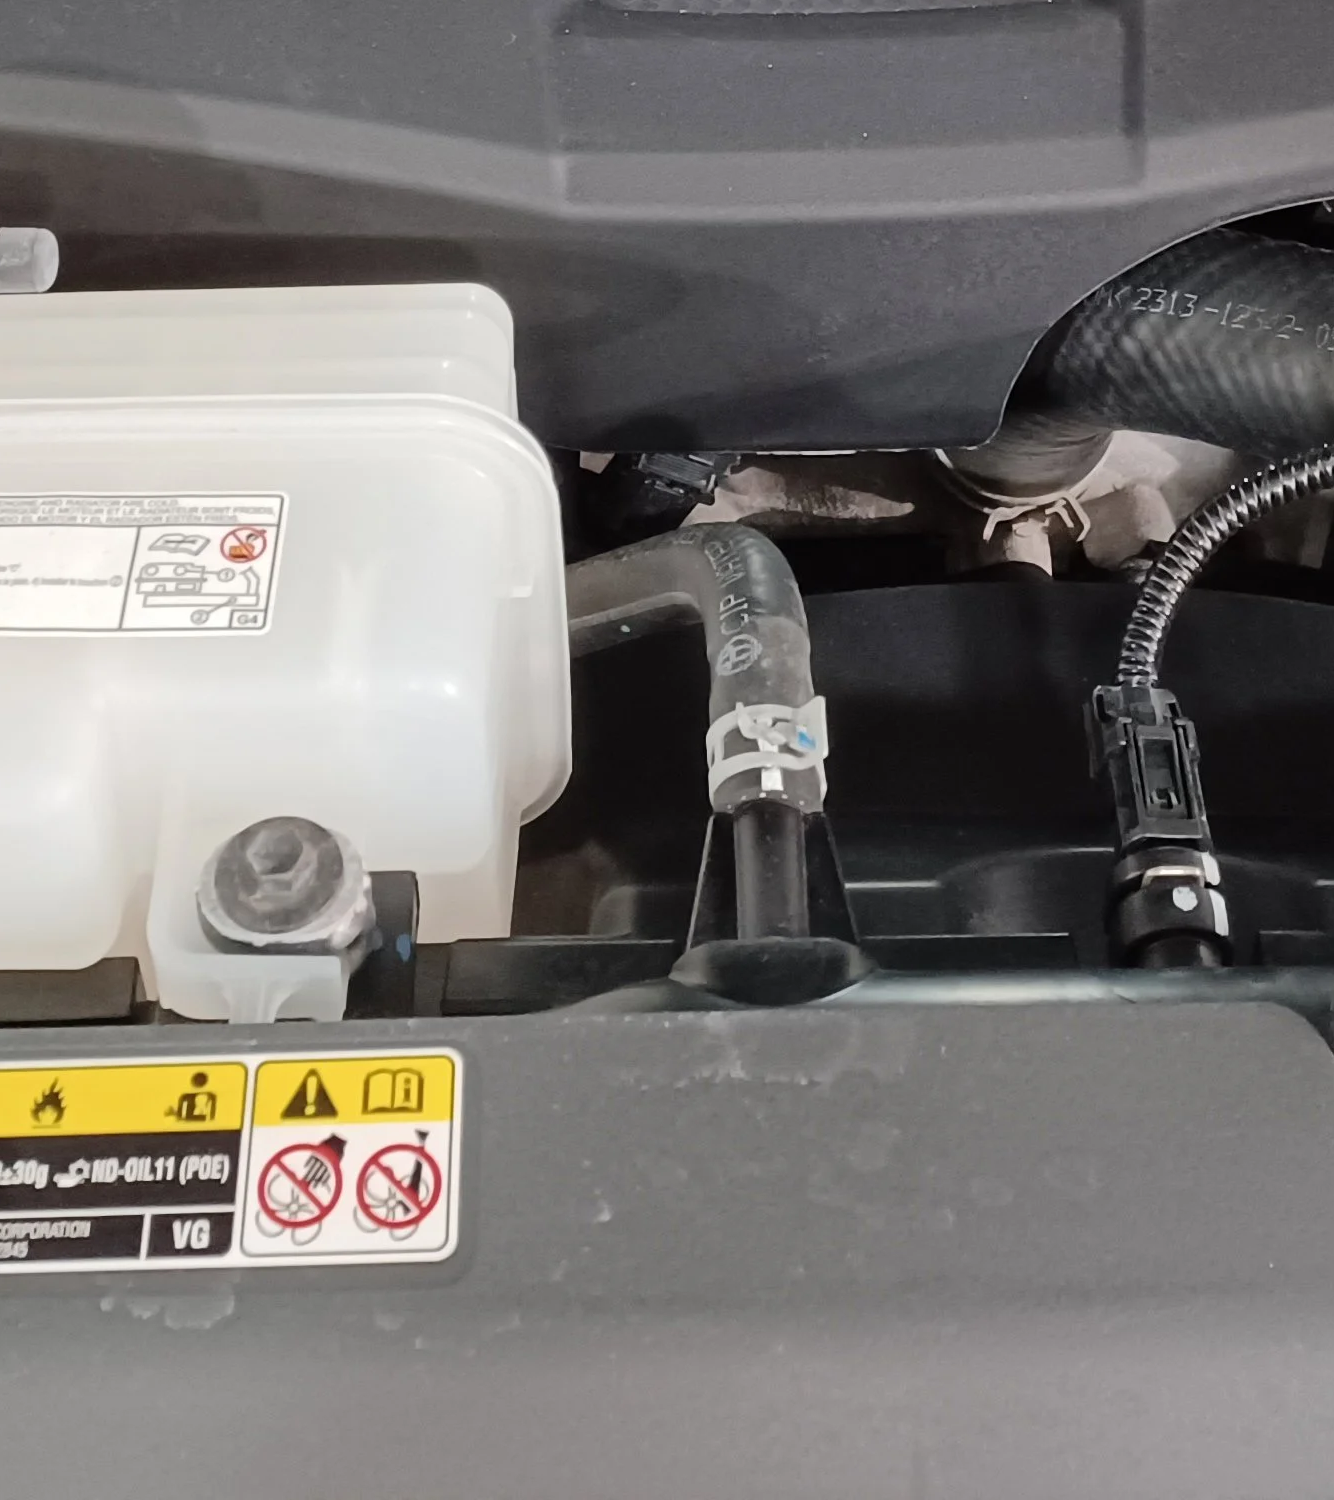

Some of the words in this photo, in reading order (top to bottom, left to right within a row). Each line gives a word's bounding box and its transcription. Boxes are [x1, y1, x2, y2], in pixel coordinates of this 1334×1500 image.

[237, 614, 258, 625] G4
[179, 1153, 231, 1186] (POE)
[173, 1218, 210, 1249] VG
